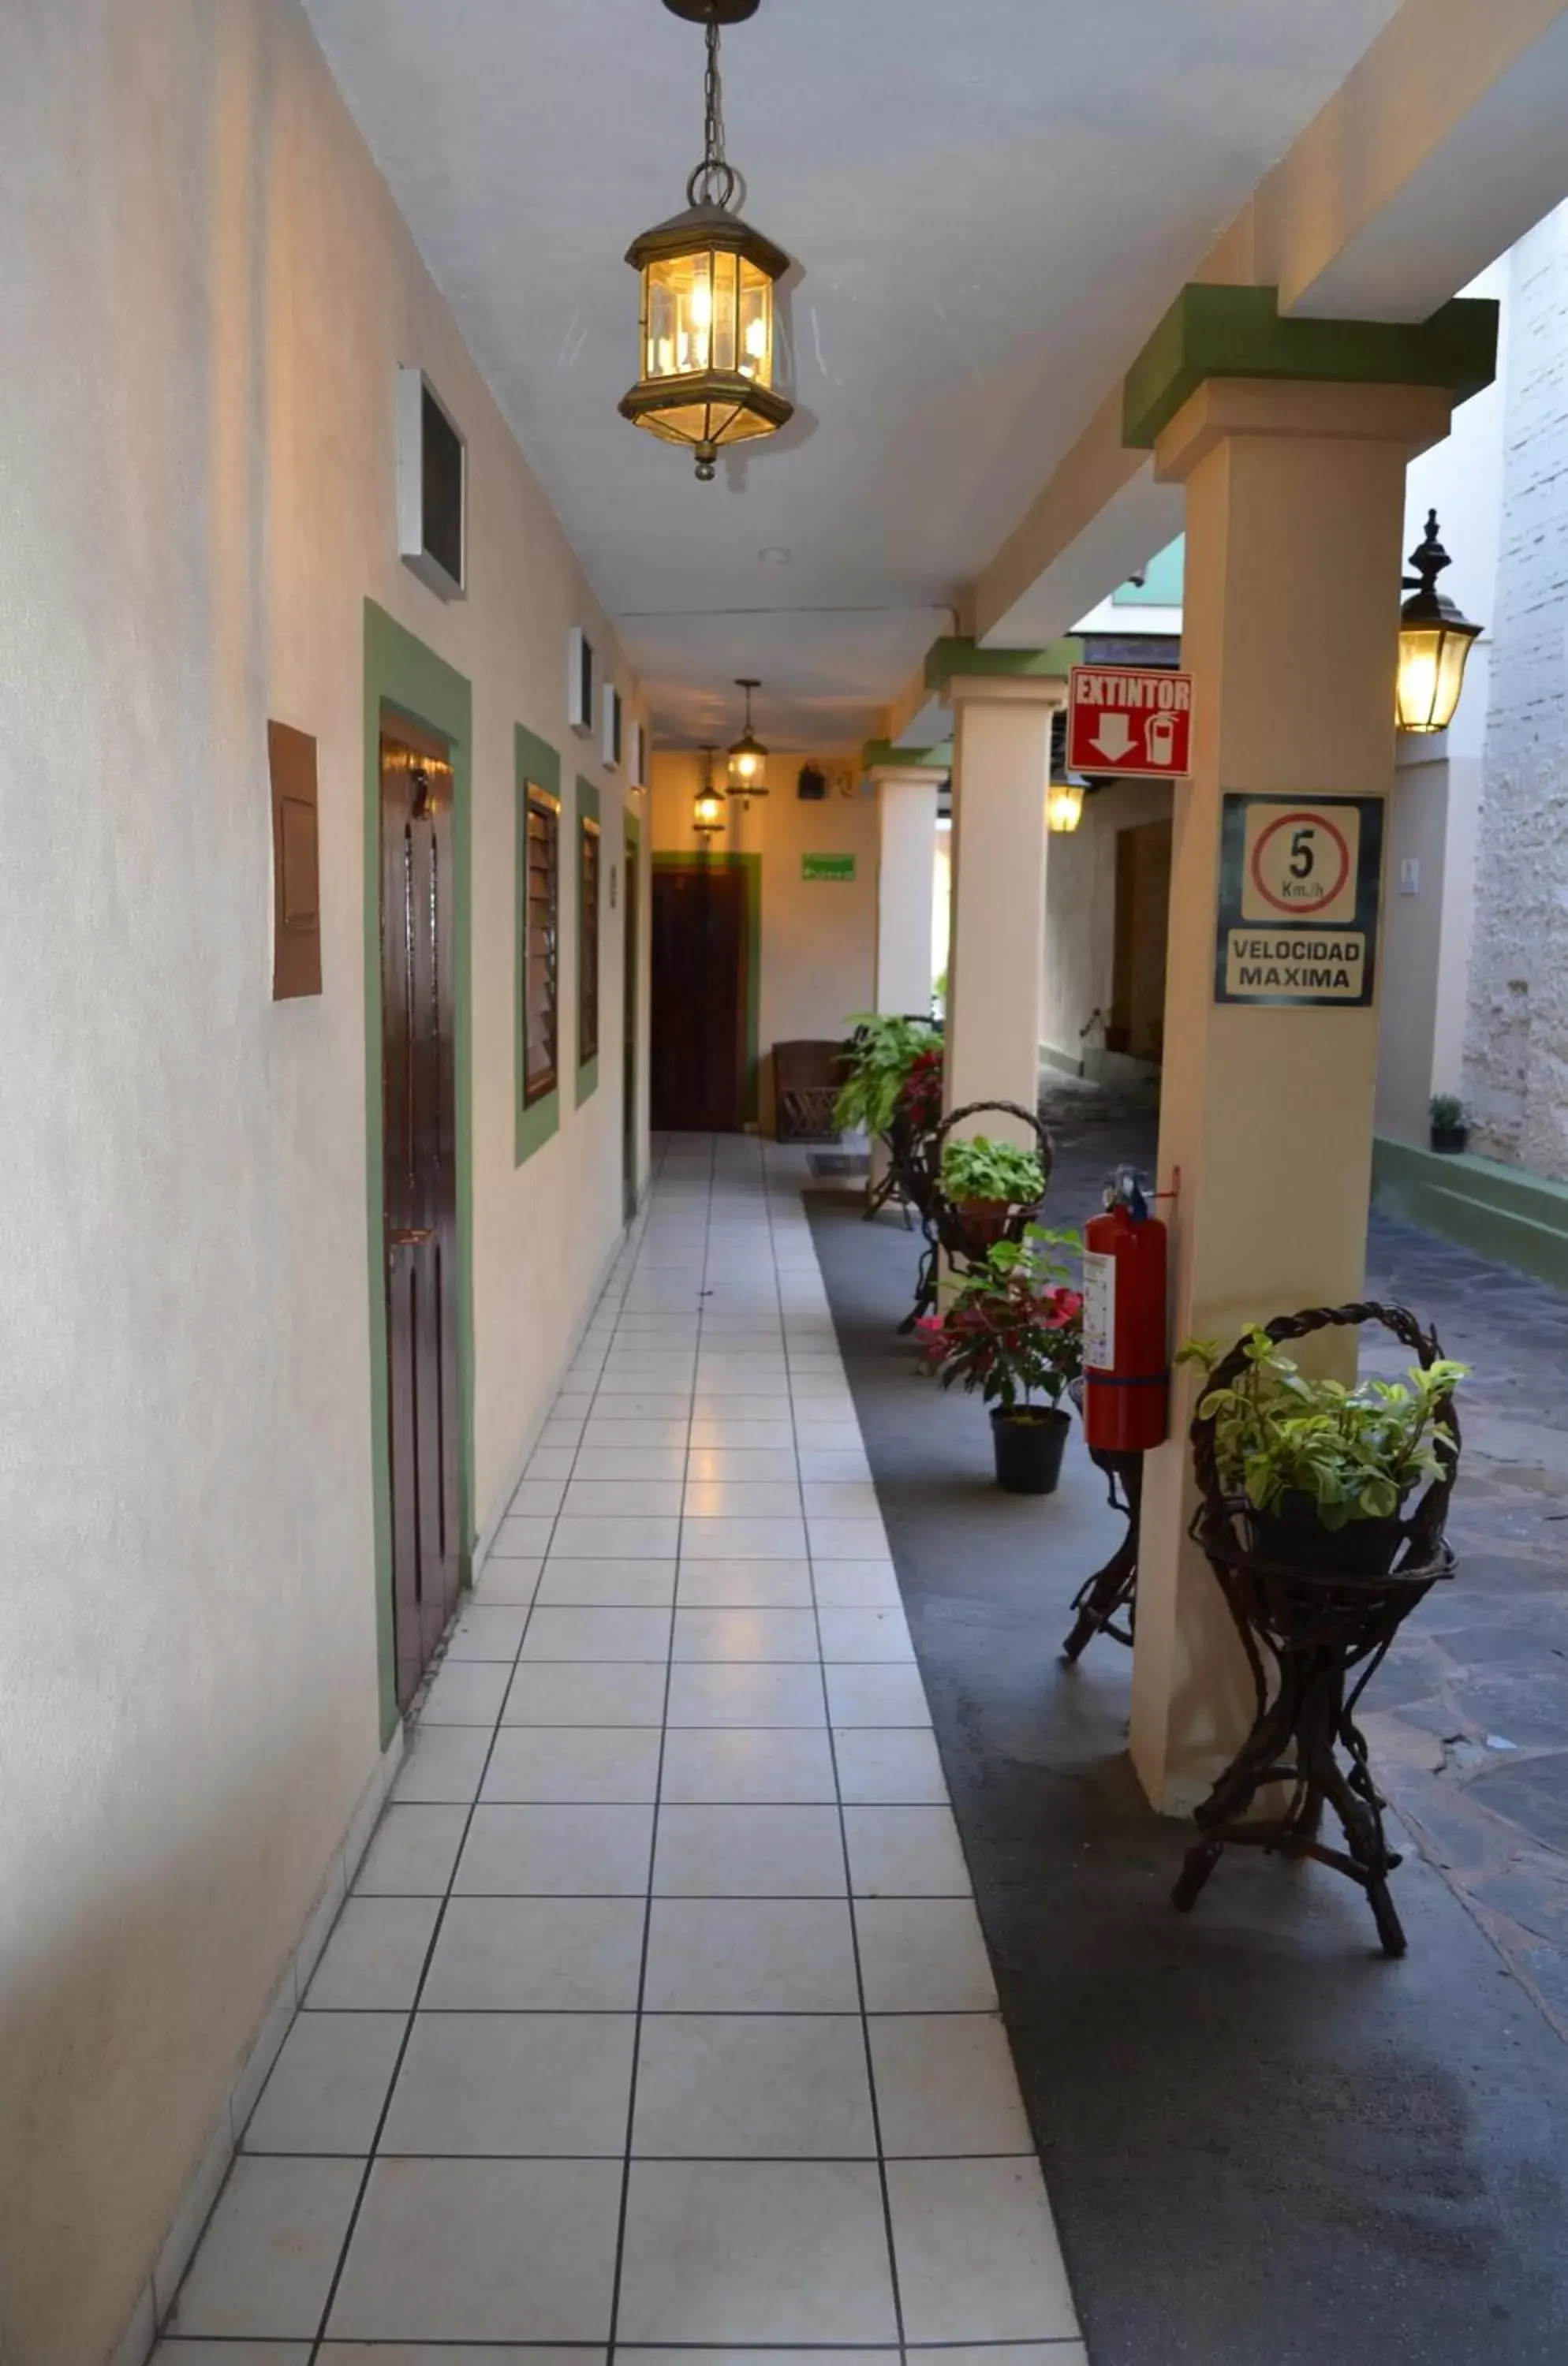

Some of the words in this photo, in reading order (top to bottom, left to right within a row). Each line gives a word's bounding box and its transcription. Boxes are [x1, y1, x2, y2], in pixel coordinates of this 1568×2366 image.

[1076, 675, 1190, 711] EXTINTOR
[1289, 829, 1315, 879] 5
[1233, 939, 1360, 962] VELOCIDAD
[1239, 968, 1350, 988] MAXIMA
